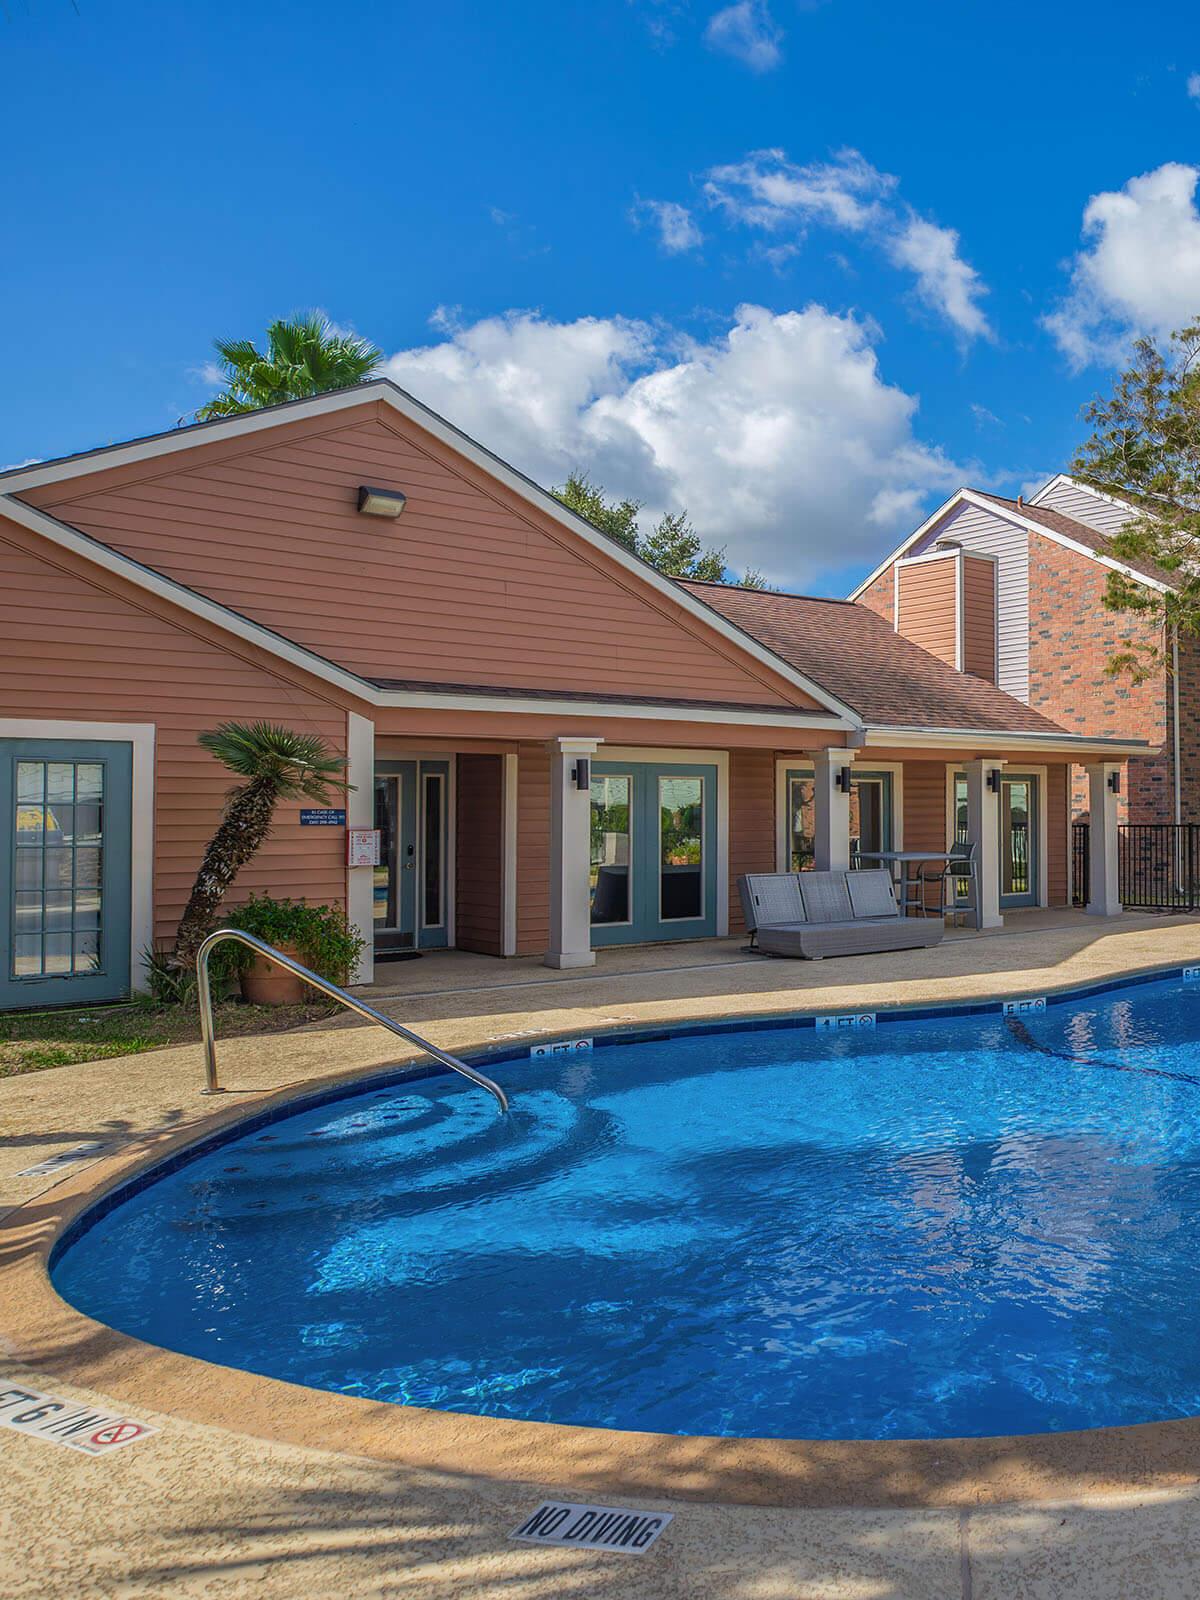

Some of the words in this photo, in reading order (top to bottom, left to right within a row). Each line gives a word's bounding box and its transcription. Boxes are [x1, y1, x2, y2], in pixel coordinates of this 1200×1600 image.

[11, 1403, 65, 1424] 6
[39, 1410, 110, 1437] IN
[518, 1506, 571, 1537] NO
[562, 1510, 663, 1548] DIVING
